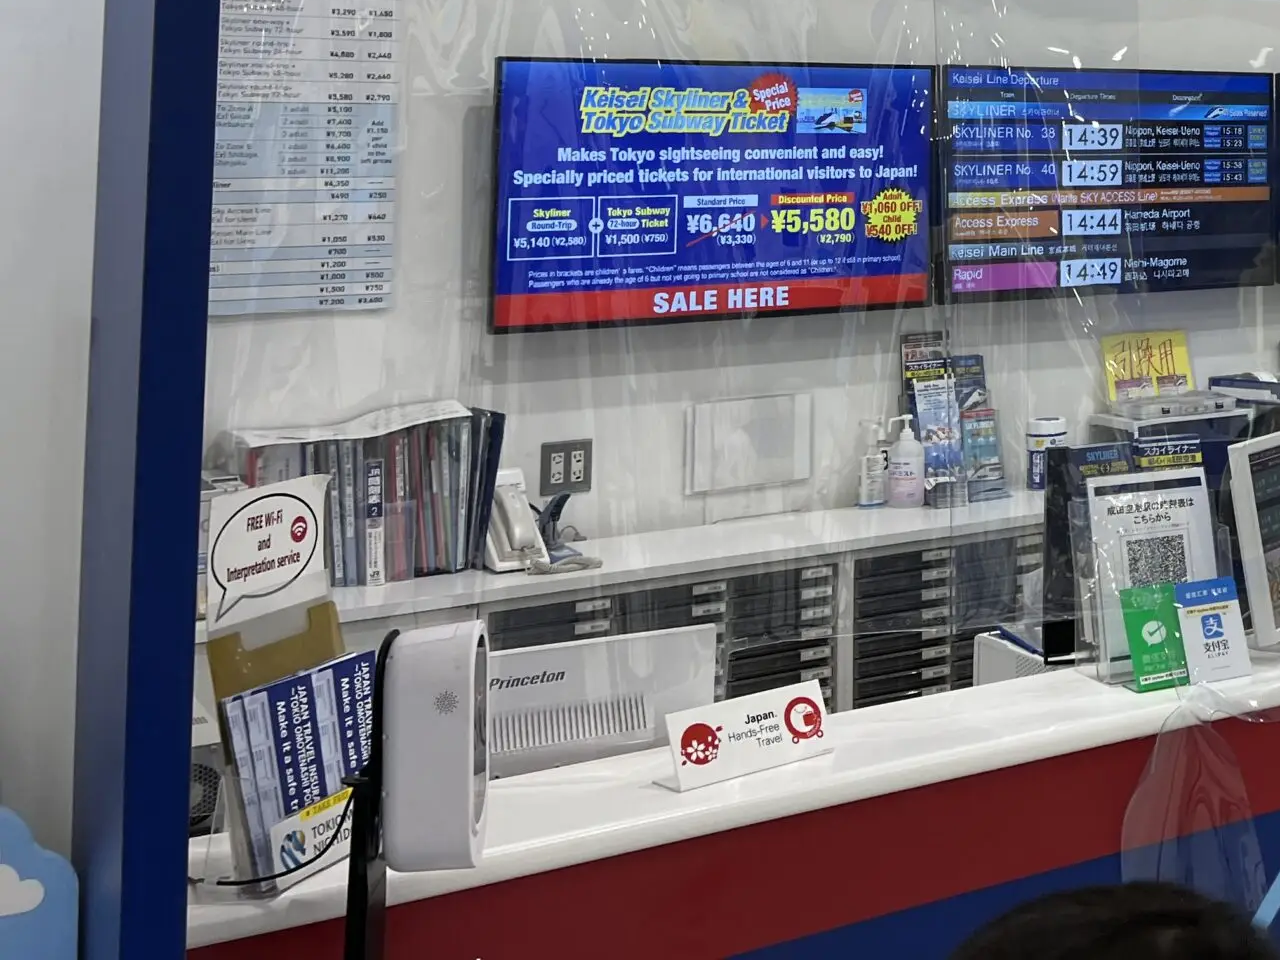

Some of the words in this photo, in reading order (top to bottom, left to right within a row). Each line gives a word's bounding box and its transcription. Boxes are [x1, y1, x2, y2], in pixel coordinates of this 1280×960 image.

[952, 73, 983, 84] Keisei
[986, 74, 1008, 84] Line
[1010, 74, 1060, 86] Departure
[753, 82, 789, 101] Special
[581, 87, 649, 110] Keisei
[651, 87, 731, 114] Skyliner
[732, 88, 750, 110] &
[765, 96, 791, 111] Price
[952, 105, 1016, 117] SKYLINER
[582, 113, 646, 136] Tokyo
[648, 113, 726, 136] Subway
[729, 111, 789, 132] Ticket
[954, 127, 1013, 139] SKYLINER
[1016, 127, 1034, 139] No.
[1041, 127, 1056, 139] 38
[1066, 127, 1120, 147] 14:39
[1156, 126, 1200, 136] Keisei-Ueno
[557, 147, 606, 162] Makes
[610, 147, 654, 164] Tokyo
[658, 146, 740, 163] sightseeing
[744, 146, 818, 160] convenient
[821, 145, 846, 159] and
[850, 145, 884, 161] easy!
[954, 164, 1013, 176] SKYLINER
[1016, 164, 1034, 175] No.
[1041, 164, 1056, 175] 40
[1156, 161, 1200, 171] Keisei-Ueno
[513, 169, 584, 188] Specially
[587, 169, 634, 187] priced
[638, 168, 689, 183] tickets
[692, 167, 713, 182] for
[716, 166, 803, 181] international
[807, 166, 855, 180] visitors
[859, 166, 873, 179] to
[875, 165, 918, 181] Japan!
[1066, 164, 1119, 183] 14:59
[697, 197, 728, 206] Standard
[729, 197, 746, 205] Price
[778, 195, 825, 204] Discounted
[826, 195, 848, 203] Price
[952, 194, 995, 206] Access
[1001, 193, 1048, 208] Express
[1080, 192, 1099, 203] SKY
[1100, 191, 1136, 203] ACCESS
[533, 208, 572, 219] Skyliner
[607, 207, 632, 217] Tokyo
[634, 206, 670, 216] Subway
[861, 201, 899, 214] ¥1,060
[900, 200, 923, 212] OFF!
[1124, 209, 1160, 219] Haneda
[1161, 208, 1191, 220] Airport
[531, 221, 572, 231] Round-Trip
[609, 220, 638, 228] 72-hour
[641, 218, 669, 227] Ticket
[687, 212, 756, 236] ¥6,640
[771, 207, 856, 234] ¥5,580
[954, 217, 993, 228] Access
[996, 215, 1039, 229] Express
[1066, 213, 1119, 231] 14:44
[866, 223, 893, 237] ¥540
[895, 223, 918, 235] OFF!
[513, 237, 550, 249] ¥5,140
[605, 234, 640, 245] ¥1,500
[641, 234, 668, 243] (¥750)
[716, 233, 756, 246] (¥3,330)
[816, 233, 855, 244] (¥2,790)
[951, 246, 984, 258] Keisei
[988, 245, 1017, 257] Main
[1020, 244, 1044, 256] Line
[1124, 257, 1188, 269] Nishi-Magome
[953, 268, 983, 282] Rapid
[1065, 261, 1118, 283] 14:49
[653, 290, 718, 314] SALE
[727, 286, 789, 309] HERE
[1086, 449, 1119, 461] SKYLINER
[1143, 445, 1197, 456] スカイライナー
[246, 514, 263, 532] FREE
[265, 509, 283, 528] Wi-Fi
[1133, 512, 1171, 525] こちらから
[257, 533, 271, 551] and
[226, 557, 276, 583] Interpretation
[277, 549, 301, 569] service
[1203, 639, 1230, 653] 支付宝
[361, 661, 371, 696] JAPAN
[489, 669, 566, 691] Princeton
[297, 685, 310, 724] JAPAN
[341, 677, 351, 714] Make
[348, 741, 357, 769] safe
[744, 711, 778, 725] Japan.
[727, 723, 780, 743] Hands-Free
[303, 723, 316, 764] TRAVEL
[755, 733, 783, 748] Travel
[276, 700, 288, 738] Make
[285, 767, 296, 797] safe
[294, 724, 310, 789] OMOTENASHI
